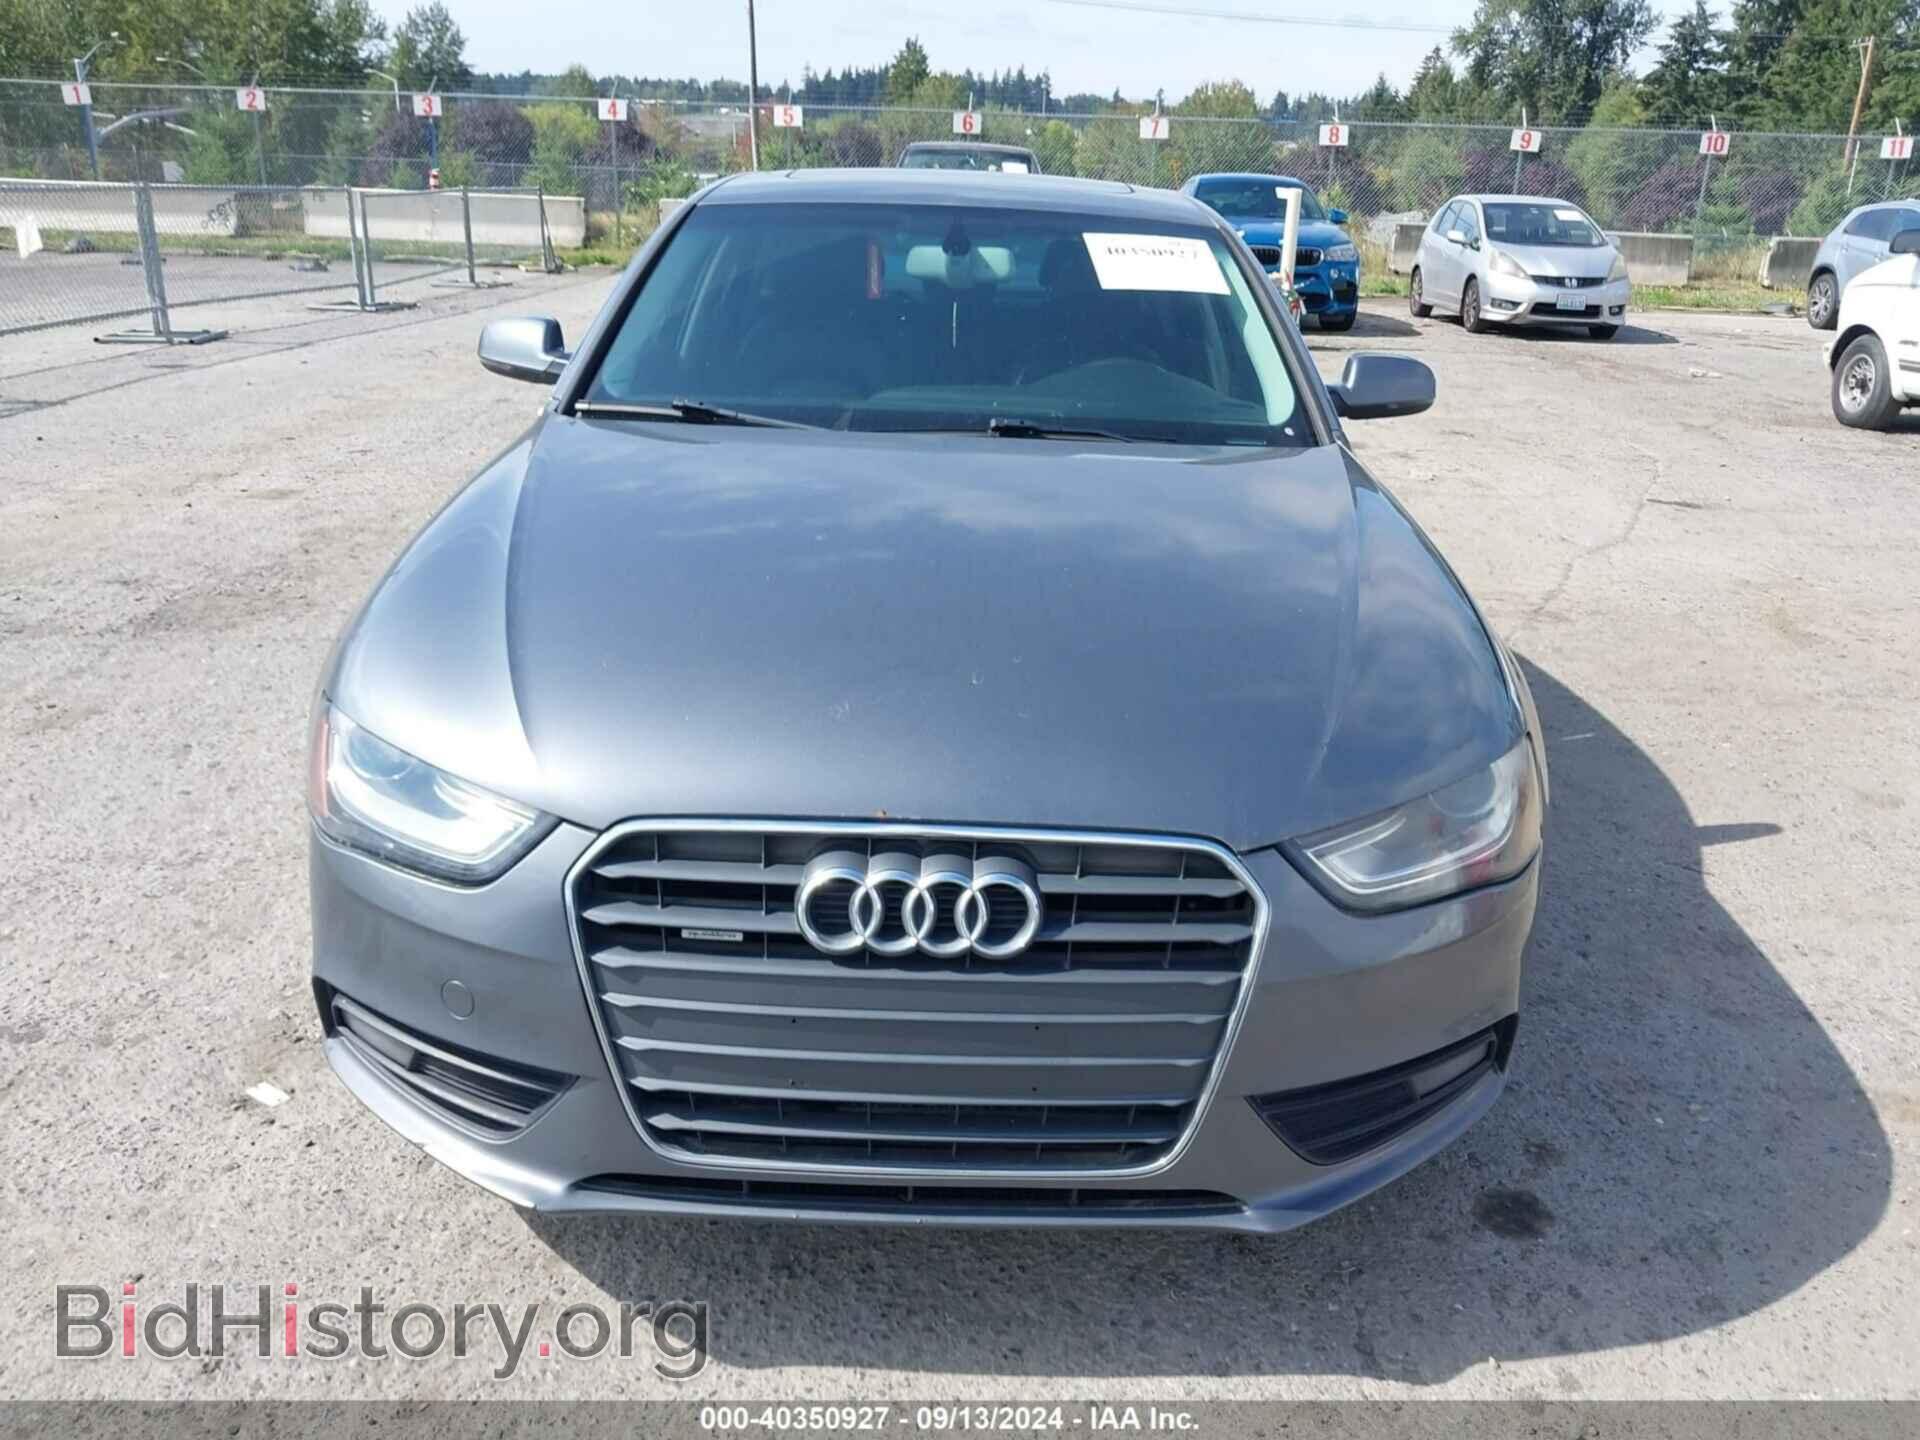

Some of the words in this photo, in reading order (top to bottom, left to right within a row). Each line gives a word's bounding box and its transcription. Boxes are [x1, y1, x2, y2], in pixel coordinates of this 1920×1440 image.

[71, 86, 81, 104] 1
[246, 91, 257, 109] 2
[422, 96, 433, 114] 3
[607, 101, 619, 119] 4
[782, 108, 794, 126] 5
[963, 114, 974, 132] 6
[1149, 121, 1159, 138] 7
[1328, 127, 1340, 145] 8
[1520, 132, 1532, 150] 9
[1705, 134, 1725, 152] 10
[1888, 139, 1904, 156] 11
